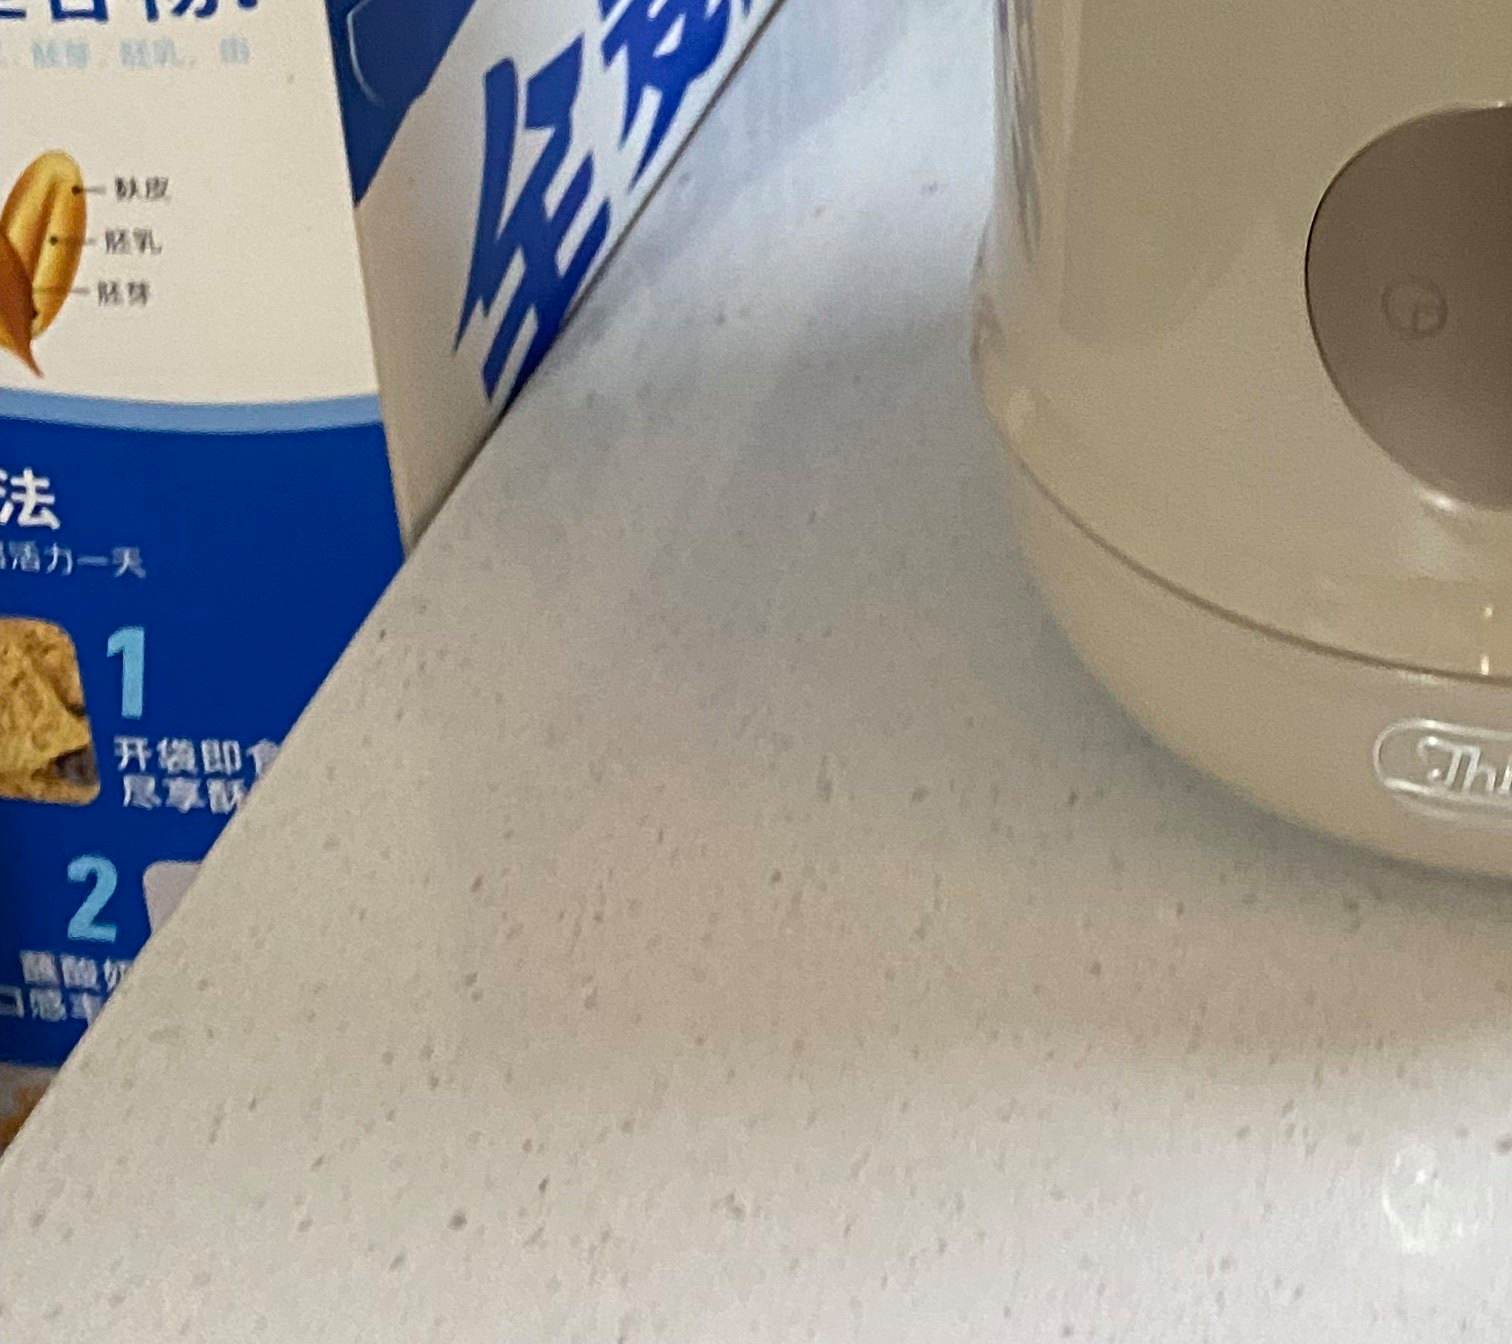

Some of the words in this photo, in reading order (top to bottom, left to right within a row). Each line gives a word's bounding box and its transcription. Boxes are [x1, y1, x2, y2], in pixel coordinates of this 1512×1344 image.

[0, 540, 147, 580] 活力一天
[106, 626, 145, 721] 1
[67, 854, 118, 944] 2
